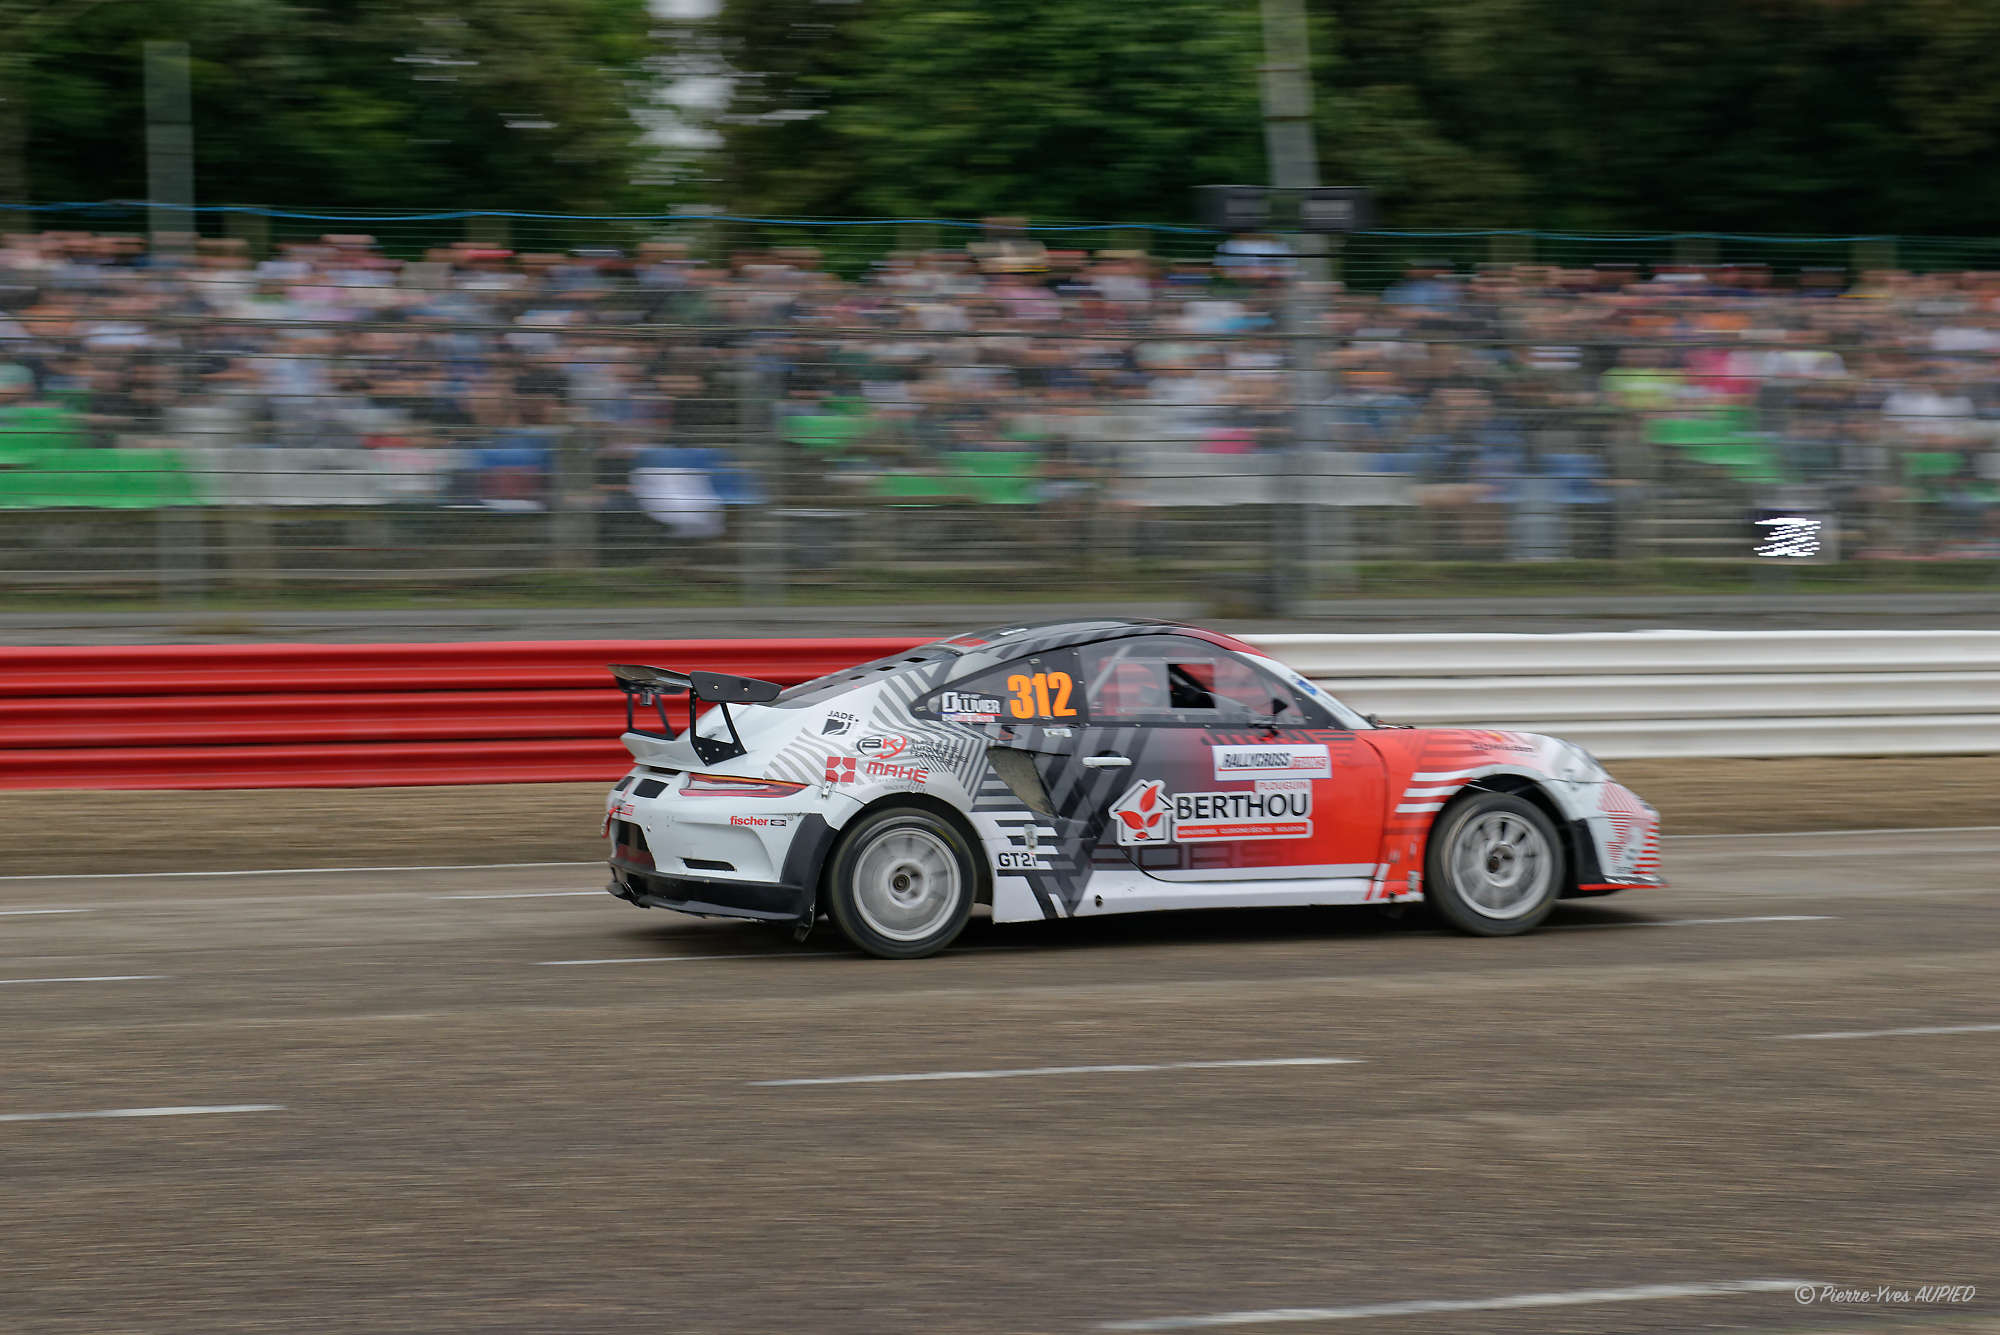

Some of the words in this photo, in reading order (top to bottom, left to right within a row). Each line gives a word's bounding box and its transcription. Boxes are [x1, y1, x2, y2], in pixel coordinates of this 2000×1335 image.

[1007, 672, 1077, 719] 312
[827, 710, 854, 721] JADE
[861, 737, 901, 750] BK
[1223, 753, 1291, 769] RALLYCROSS
[866, 761, 929, 784] MAHE
[1176, 793, 1309, 820] BERTHOU
[730, 816, 768, 826] fischer
[998, 852, 1036, 867] GT2i
